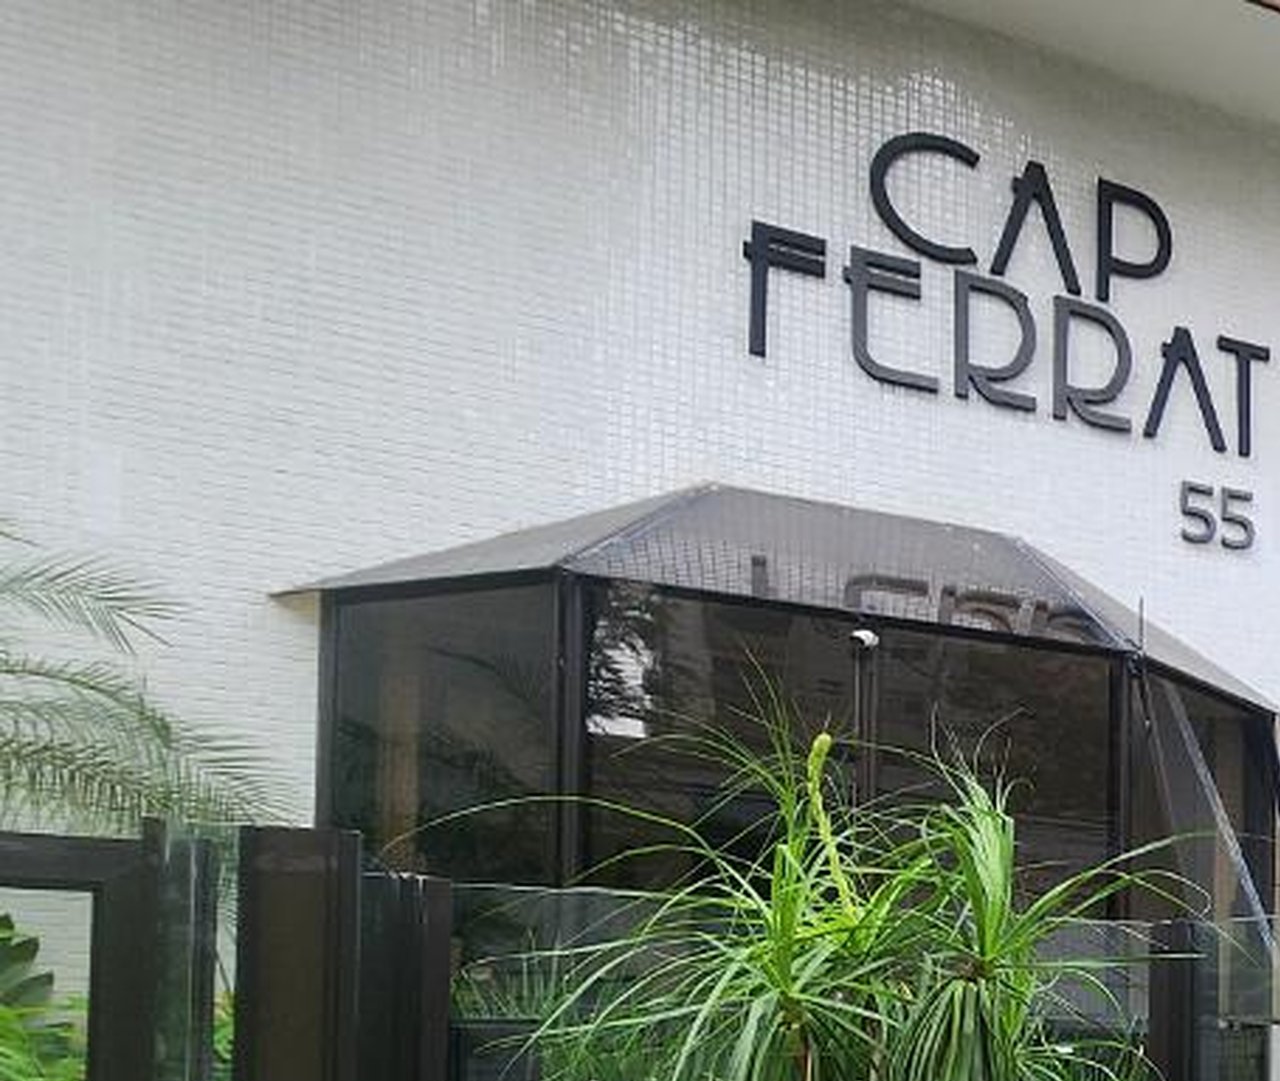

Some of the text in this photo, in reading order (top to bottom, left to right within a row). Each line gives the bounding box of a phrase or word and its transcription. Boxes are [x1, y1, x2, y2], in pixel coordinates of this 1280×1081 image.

[869, 131, 1172, 302] CAP
[743, 220, 1271, 458] FERRAT
[1179, 481, 1254, 551] 55
